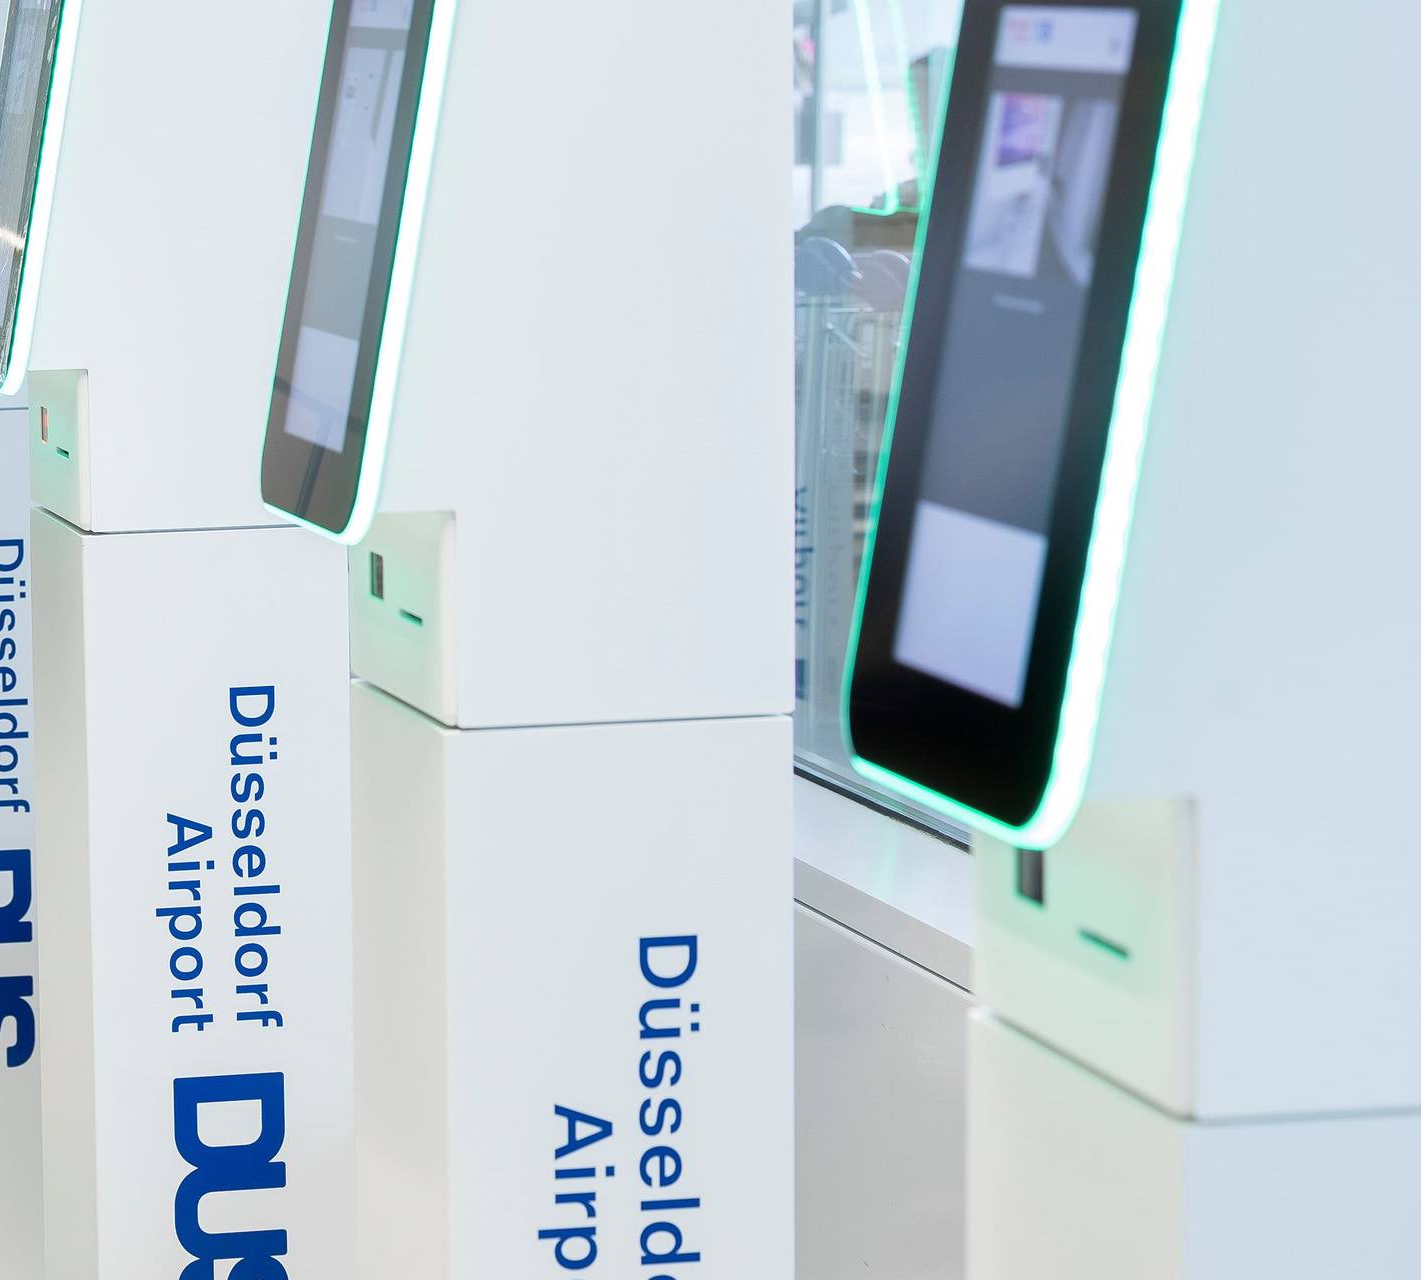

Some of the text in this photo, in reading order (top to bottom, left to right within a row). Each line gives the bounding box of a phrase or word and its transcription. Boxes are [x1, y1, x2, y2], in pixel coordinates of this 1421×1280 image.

[155, 812, 215, 1034] Airport
[227, 685, 284, 1028] Düsseldorf
[173, 1072, 289, 1280] DU
[537, 1103, 616, 1280] Airp
[638, 934, 702, 1280] Düsseld
